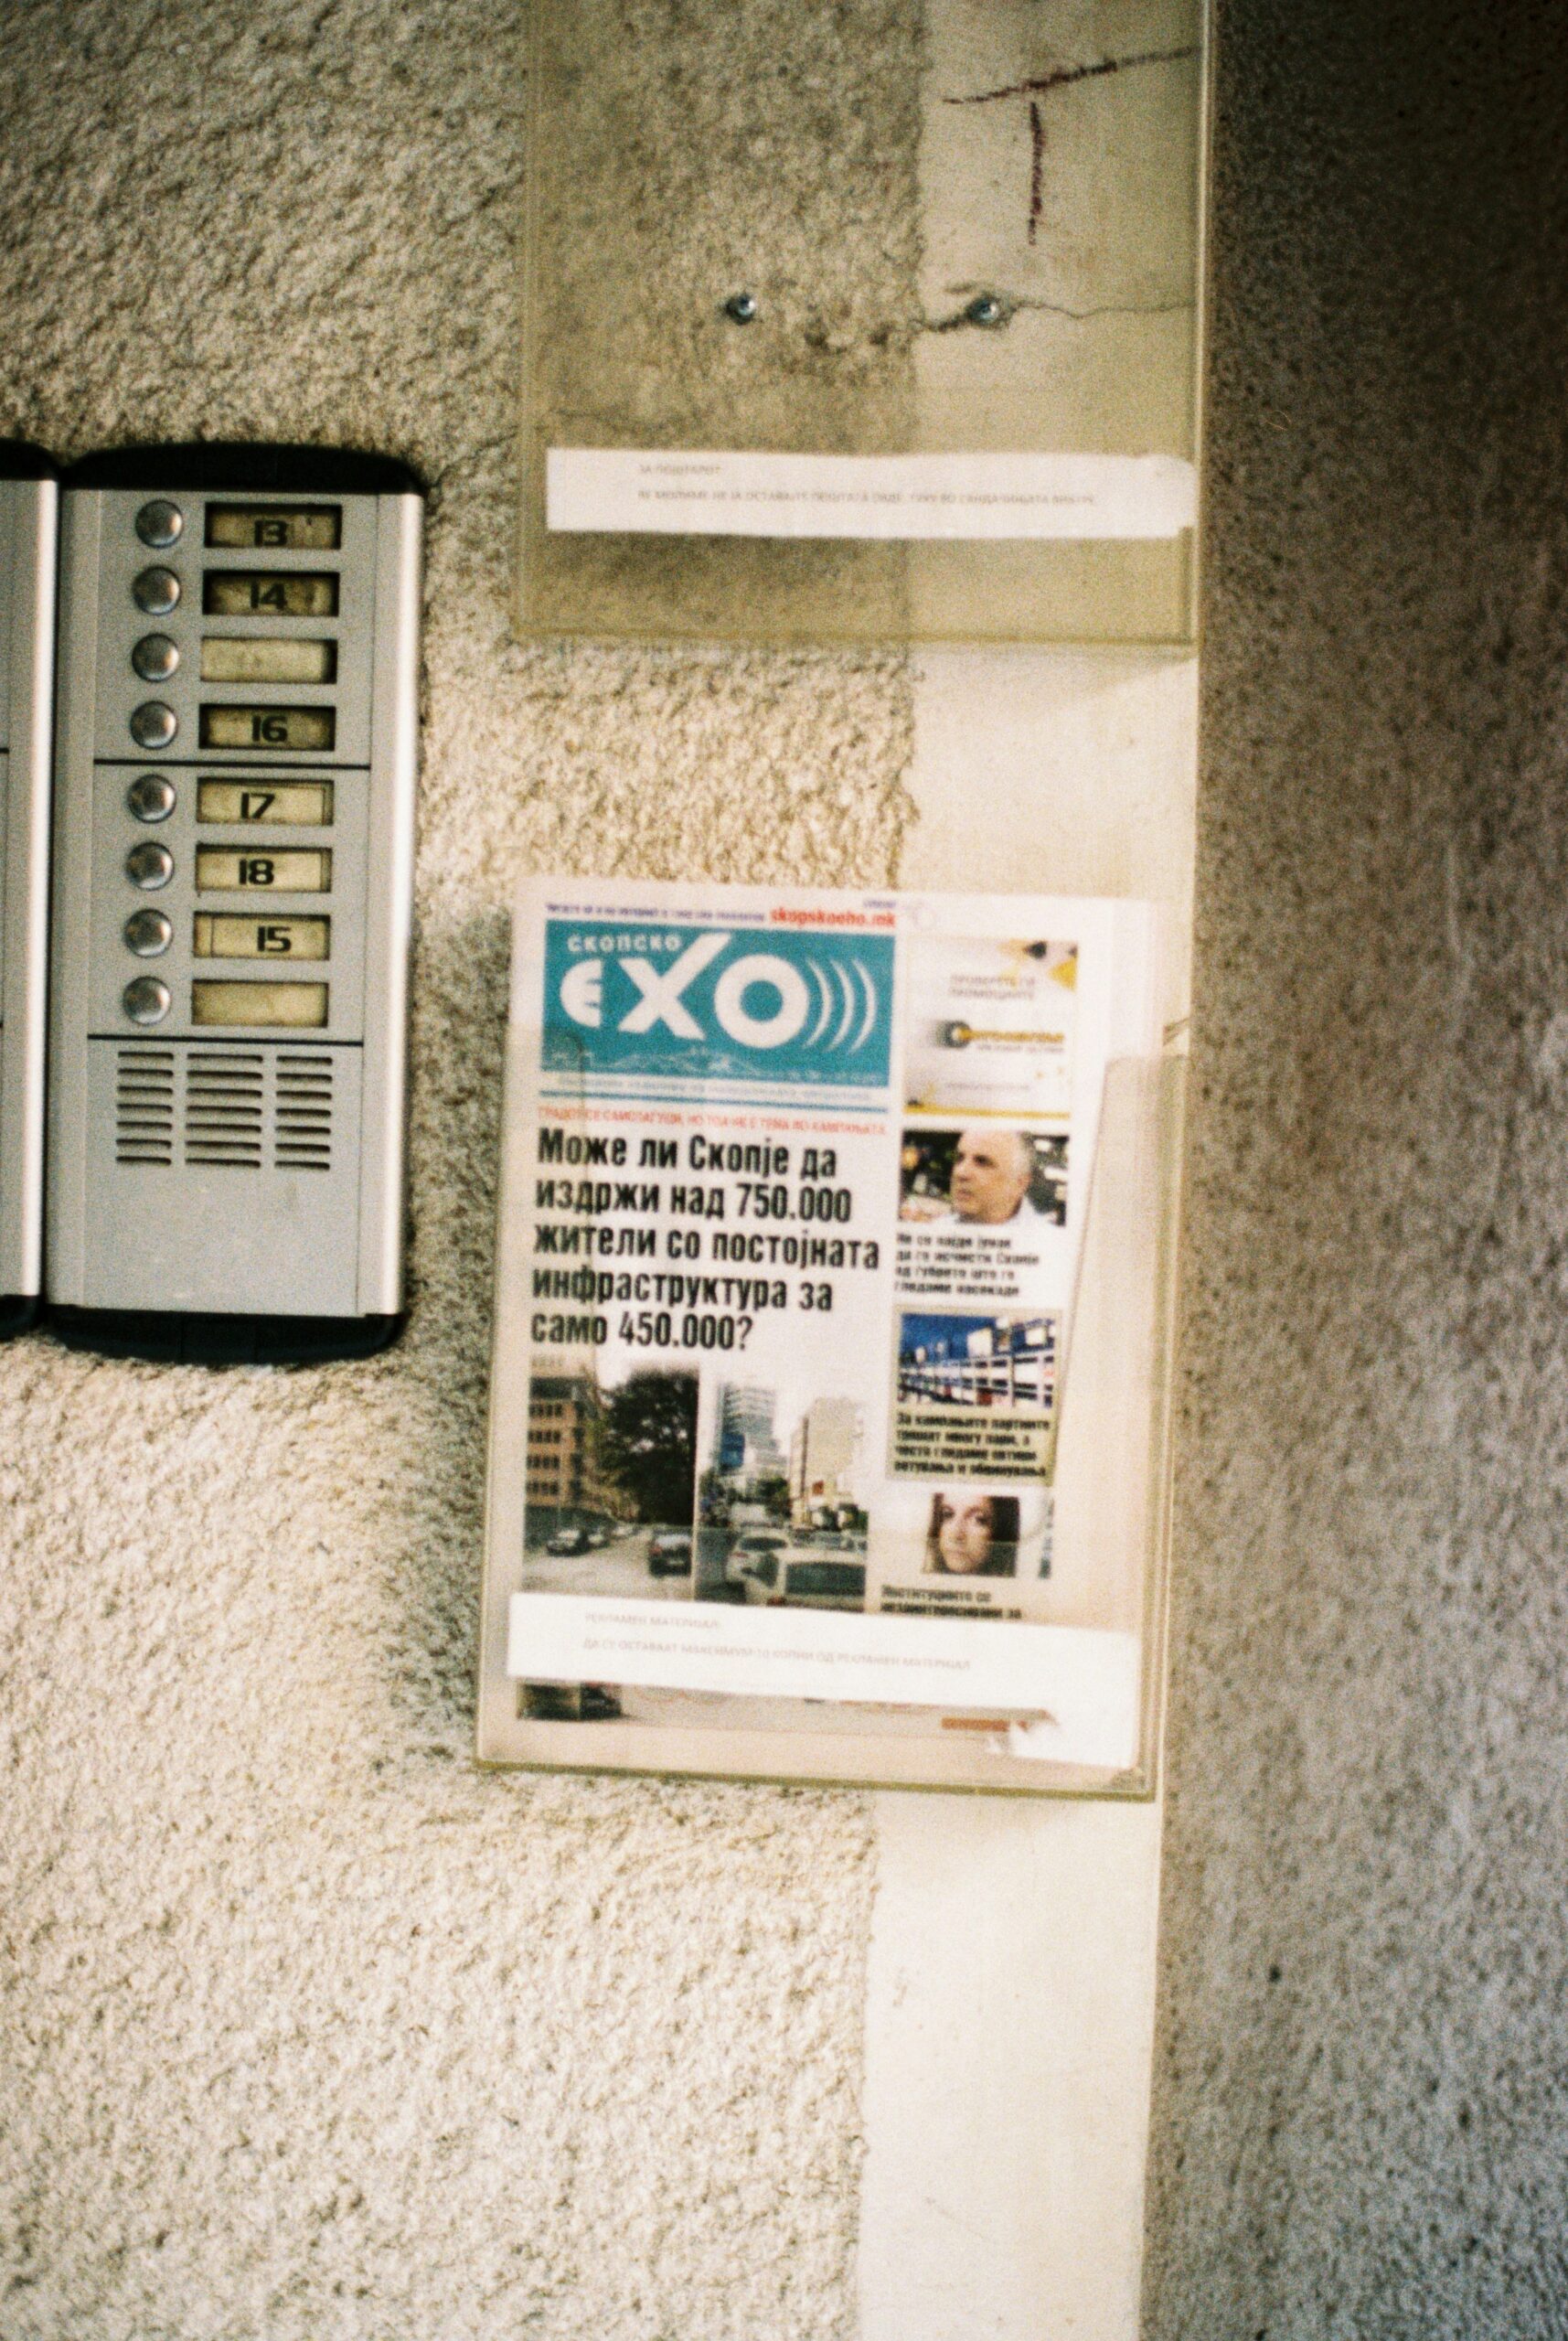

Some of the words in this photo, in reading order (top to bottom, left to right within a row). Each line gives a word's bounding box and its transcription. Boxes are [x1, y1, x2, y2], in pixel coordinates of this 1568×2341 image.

[253, 519, 289, 547] 13
[250, 582, 287, 610] 14
[251, 715, 288, 742] 16
[240, 792, 275, 819] 17
[239, 859, 274, 885] 18
[256, 925, 292, 953] 15
[537, 1127, 627, 1166] Може
[638, 1138, 677, 1170] ли
[688, 1135, 789, 1179] Скопје
[800, 1148, 837, 1181] да
[535, 1180, 660, 1215] издржи
[670, 1184, 725, 1220] над
[735, 1182, 852, 1223] 750.000
[534, 1224, 656, 1257] жители
[667, 1231, 700, 1261] со
[711, 1229, 880, 1270] постојната
[532, 1265, 787, 1311] инфраструктура
[798, 1282, 833, 1311] за
[530, 1311, 608, 1346] само
[618, 1311, 753, 1351] 450.000?
